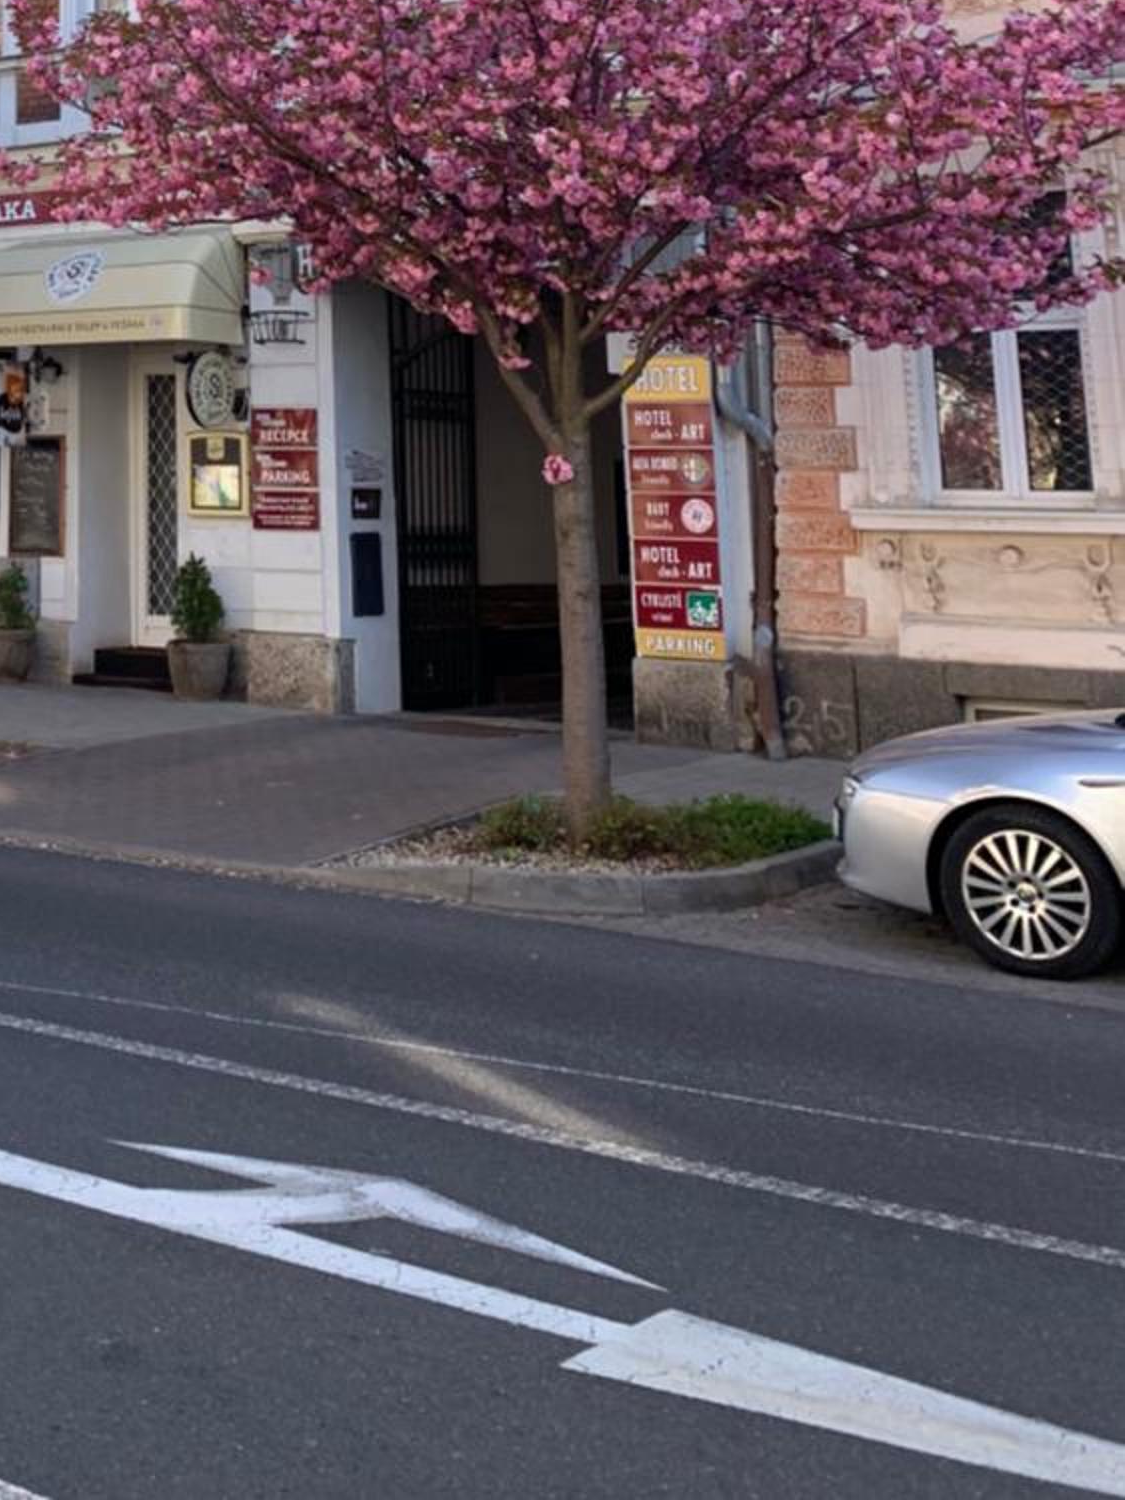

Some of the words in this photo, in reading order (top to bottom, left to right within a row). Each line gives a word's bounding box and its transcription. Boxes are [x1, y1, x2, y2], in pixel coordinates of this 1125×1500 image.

[635, 366, 699, 392] HOTEL
[635, 410, 672, 426] HOTEL
[681, 423, 705, 440] ART
[261, 469, 310, 484] PARKING
[640, 546, 680, 564] HOTEL
[687, 562, 713, 579] ART
[646, 635, 715, 656] PARKING
